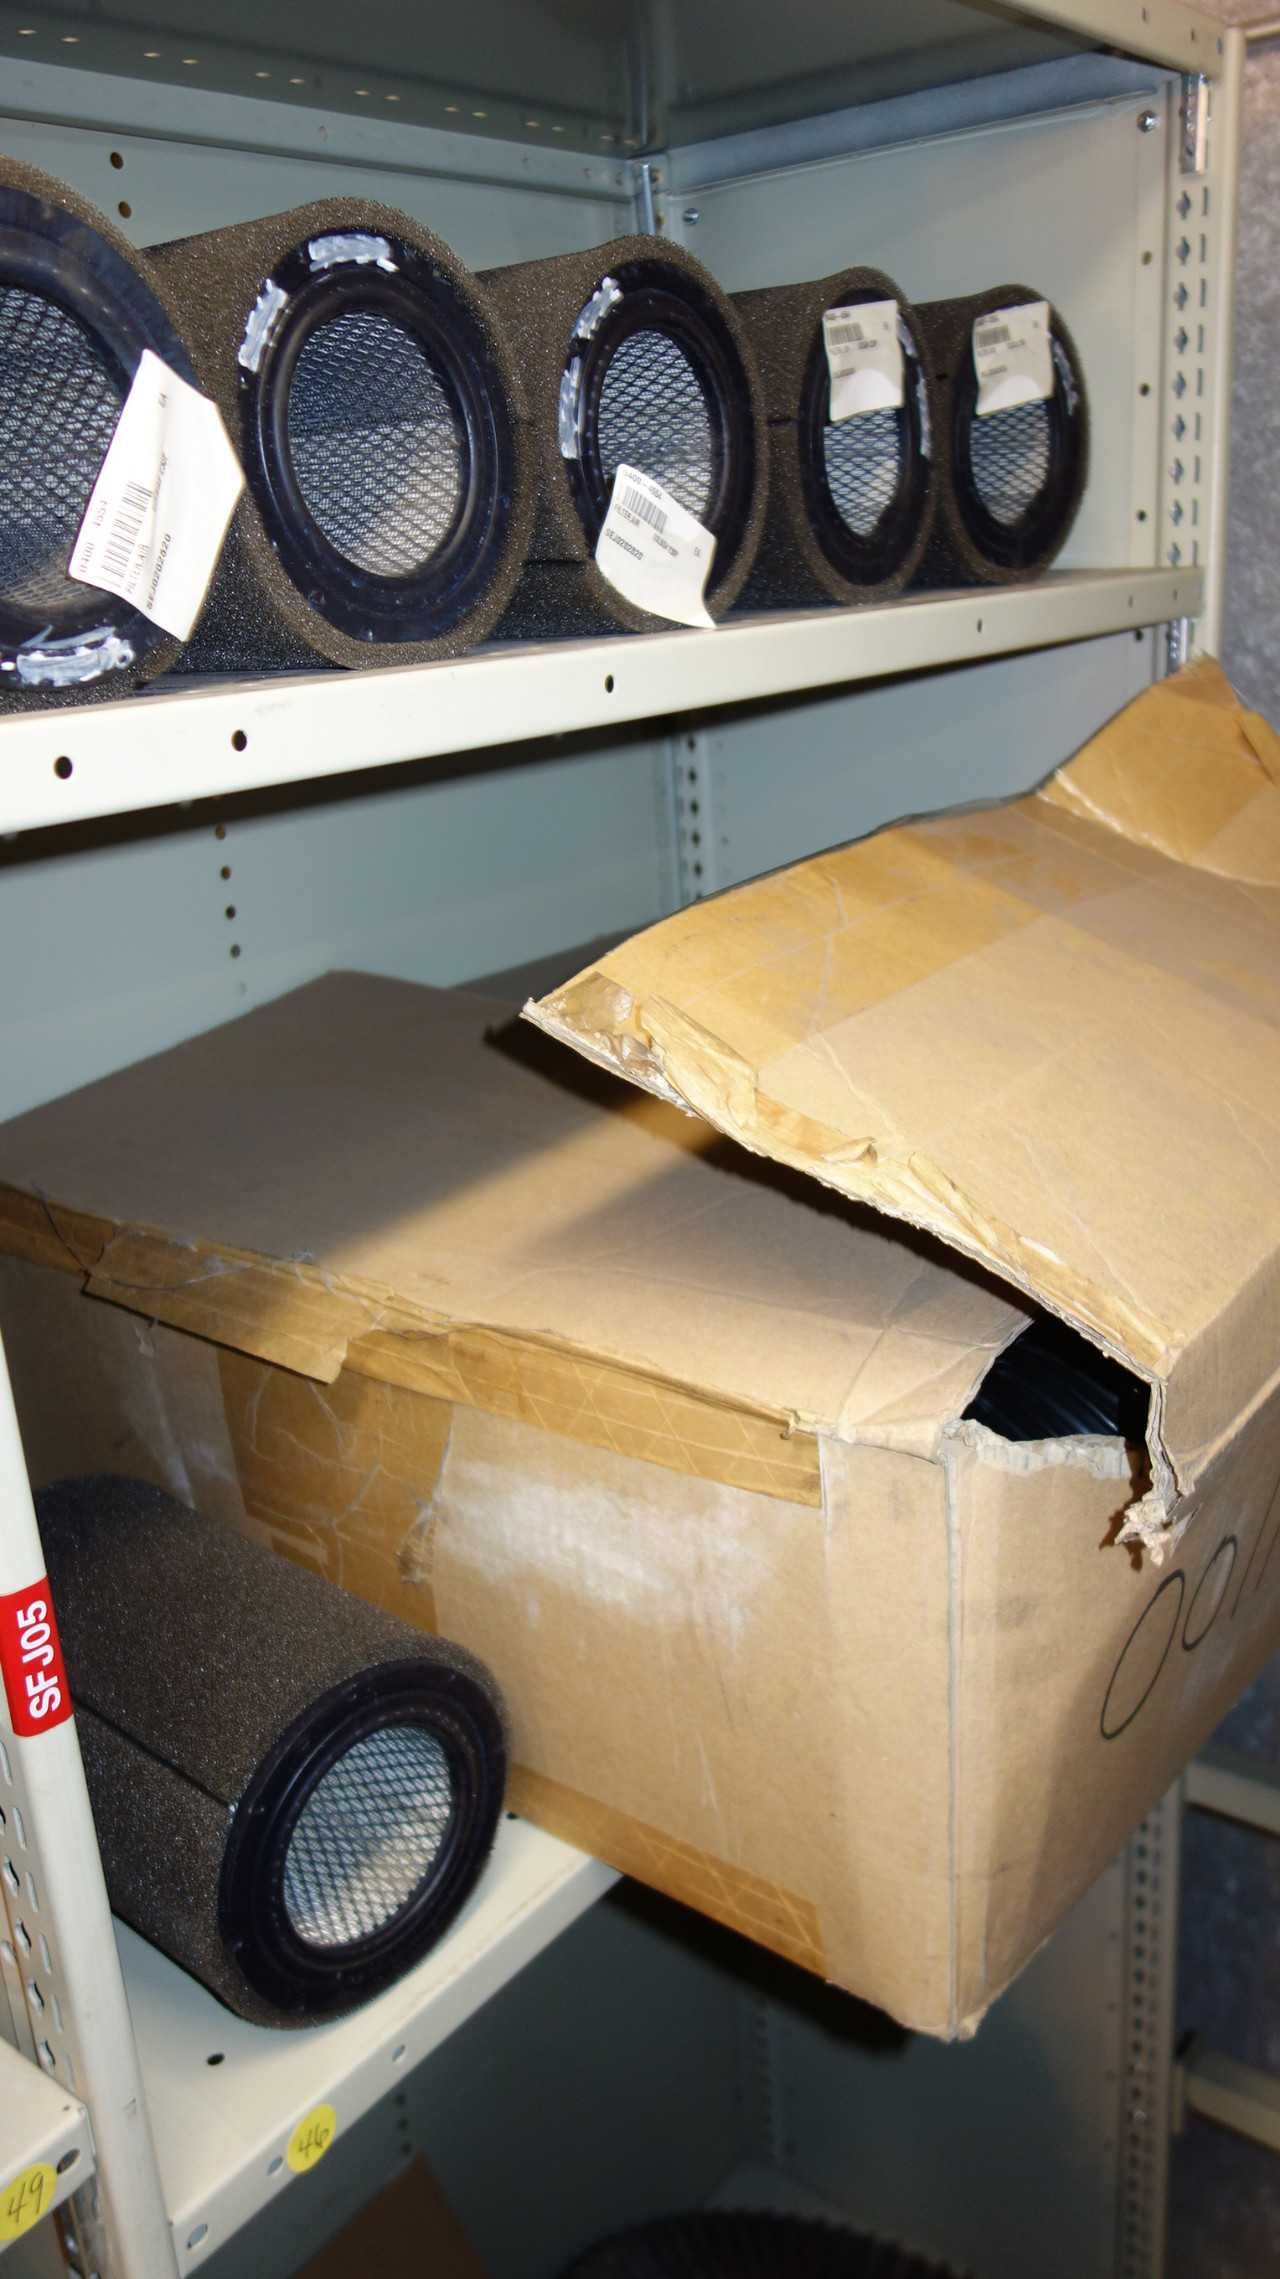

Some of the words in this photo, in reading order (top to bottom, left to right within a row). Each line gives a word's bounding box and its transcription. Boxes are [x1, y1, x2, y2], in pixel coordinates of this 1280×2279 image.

[16, 1600, 54, 1666] J05
[25, 1671, 61, 1718] SF
[7, 2171, 44, 2224] 49
